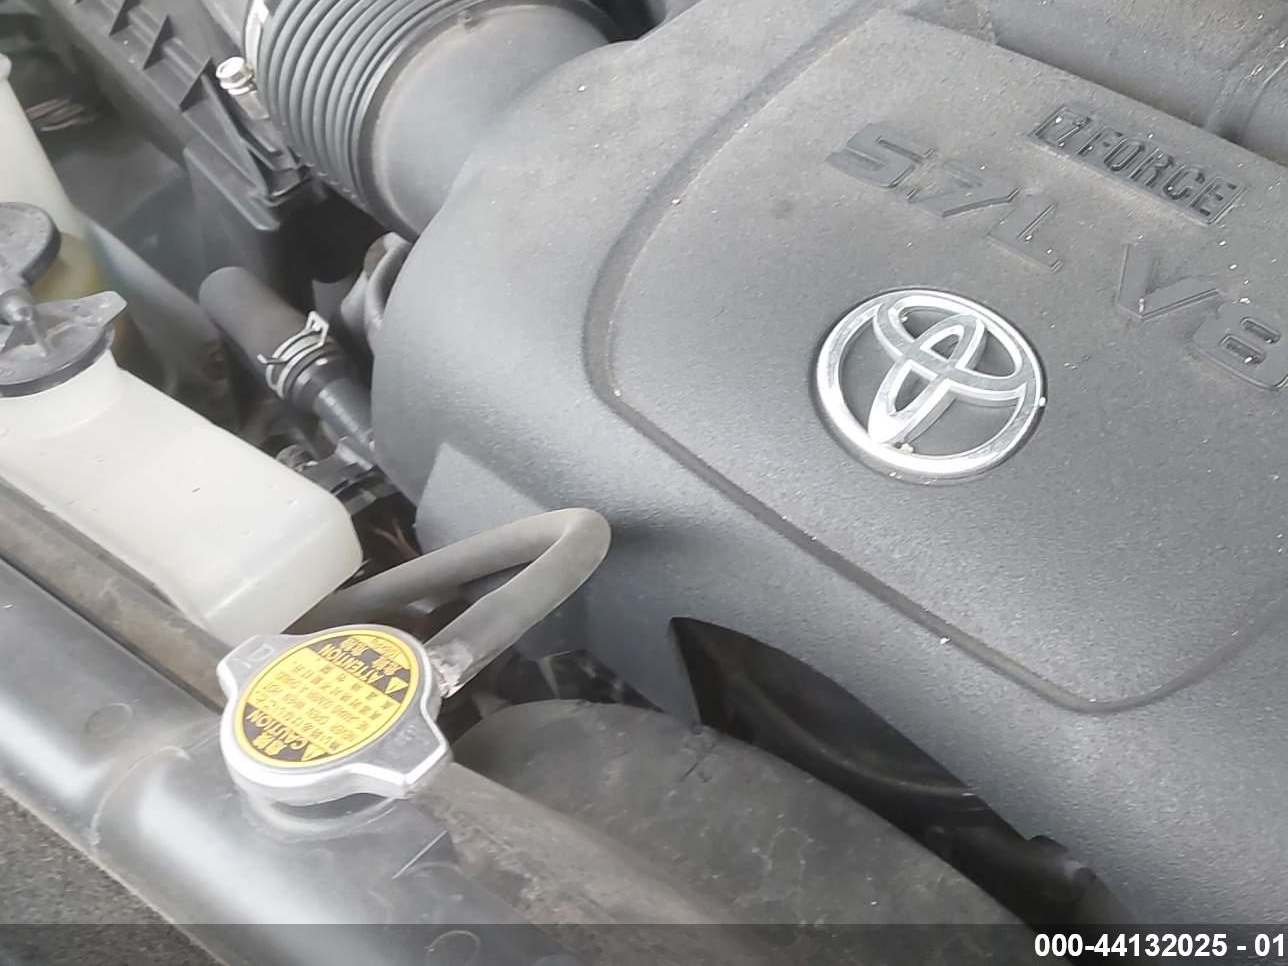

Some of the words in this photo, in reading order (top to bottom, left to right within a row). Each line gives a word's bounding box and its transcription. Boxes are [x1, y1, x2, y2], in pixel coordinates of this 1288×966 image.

[825, 124, 1064, 274] 5.7L
[318, 643, 385, 685] ATTENTION
[246, 709, 308, 751] CAUTION
